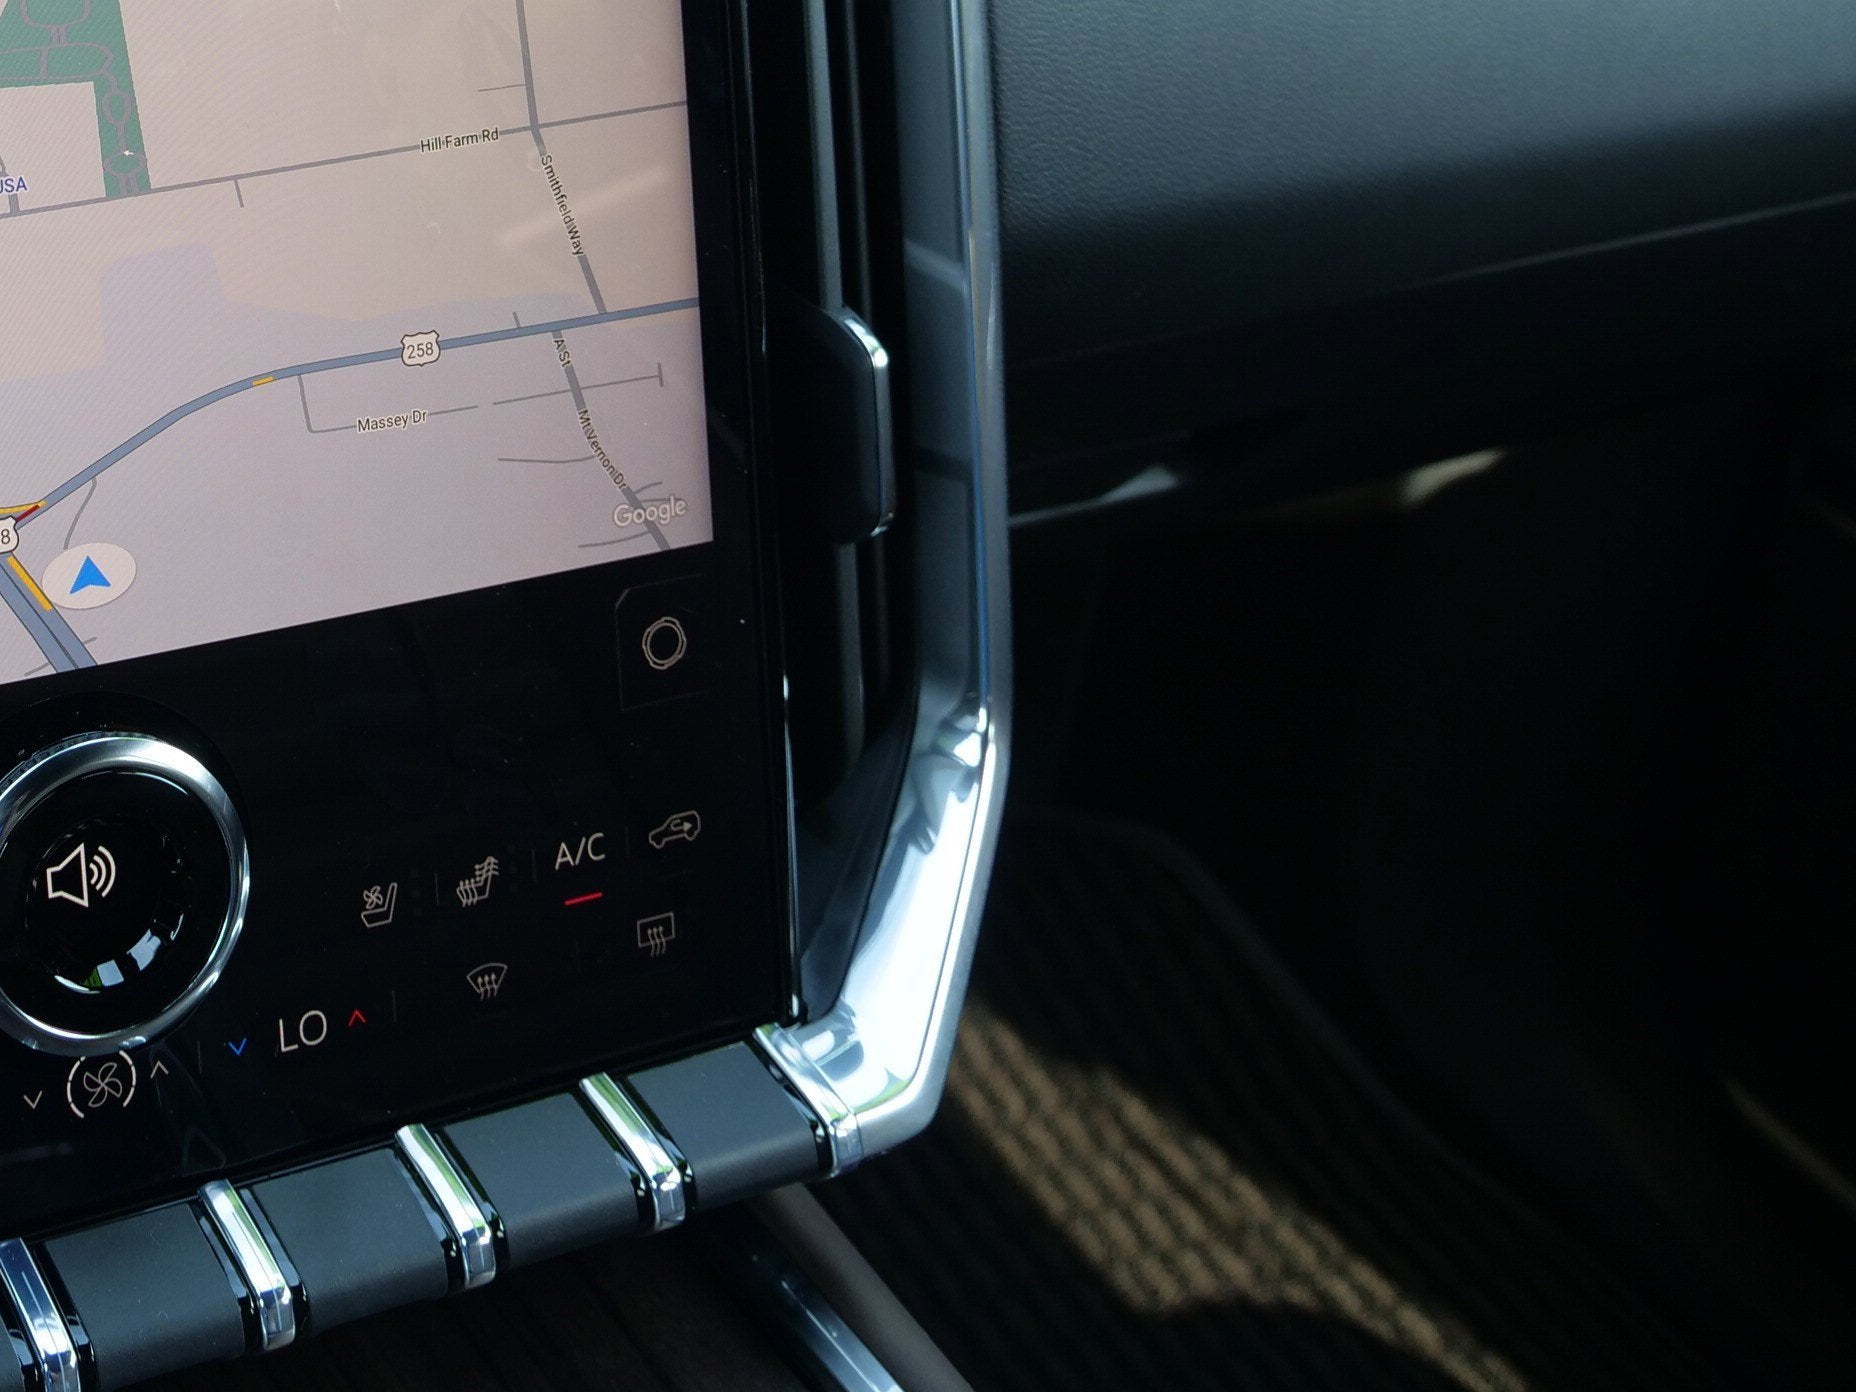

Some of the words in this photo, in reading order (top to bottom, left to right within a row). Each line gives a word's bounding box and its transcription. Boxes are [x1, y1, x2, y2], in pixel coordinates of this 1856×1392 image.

[420, 138, 442, 153] Hill
[446, 133, 480, 150] Farm
[483, 128, 500, 144] Rd
[541, 154, 574, 226] Smithfield
[568, 227, 584, 256] Way
[406, 342, 434, 359] 258
[554, 339, 565, 351] A
[556, 351, 572, 367] St
[357, 412, 409, 434] Massey
[412, 410, 427, 424] Dr
[578, 410, 592, 427] Mt
[585, 429, 618, 474] Vernon
[612, 472, 627, 489] Dr
[614, 496, 687, 527] Google
[554, 833, 606, 870] A/C
[279, 1011, 327, 1054] LO
